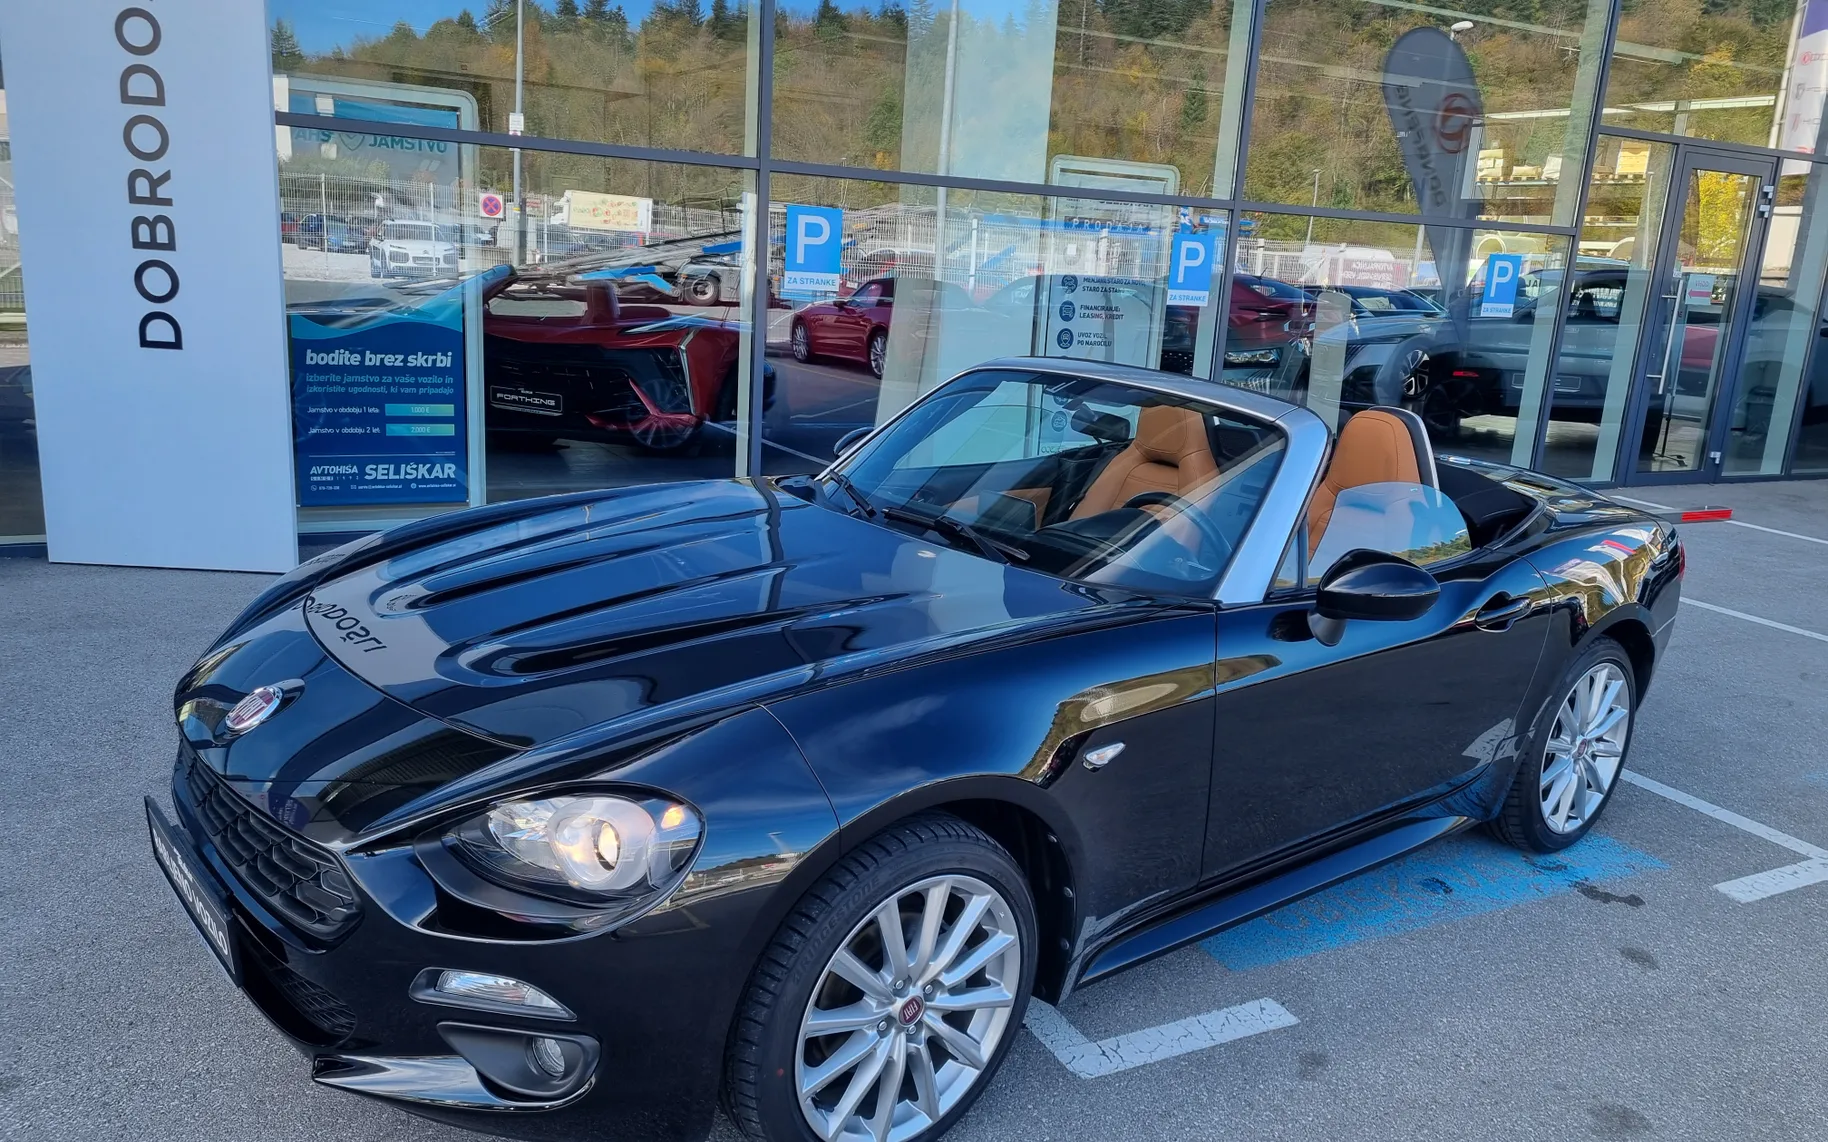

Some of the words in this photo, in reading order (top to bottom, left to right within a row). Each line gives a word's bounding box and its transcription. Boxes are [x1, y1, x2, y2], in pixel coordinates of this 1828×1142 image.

[114, 0, 183, 350] DOBRODO
[796, 214, 831, 264] P
[1177, 241, 1206, 283] P
[787, 276, 798, 284] ZA
[800, 277, 836, 286] STRANKE
[1490, 260, 1513, 297] P
[306, 349, 361, 366] bodite
[364, 350, 404, 366] brez
[407, 352, 452, 367] skrbi
[306, 373, 341, 382] izberite
[343, 374, 379, 383] jamstvo
[395, 374, 415, 383] vaše
[418, 375, 443, 383] vozilo
[445, 375, 453, 383] in
[307, 385, 345, 393] izkoristite
[348, 385, 388, 394] ugodnosti,
[418, 386, 454, 395] pripadajo
[497, 393, 555, 406] FORTHING
[338, 406, 362, 414] obdobju
[341, 426, 365, 435] obdobju
[310, 464, 359, 475] AVTOHIŠA
[364, 462, 456, 480] SELIŠKAR
[192, 890, 228, 956] VOZILO
[903, 1000, 919, 1021] FIAT
